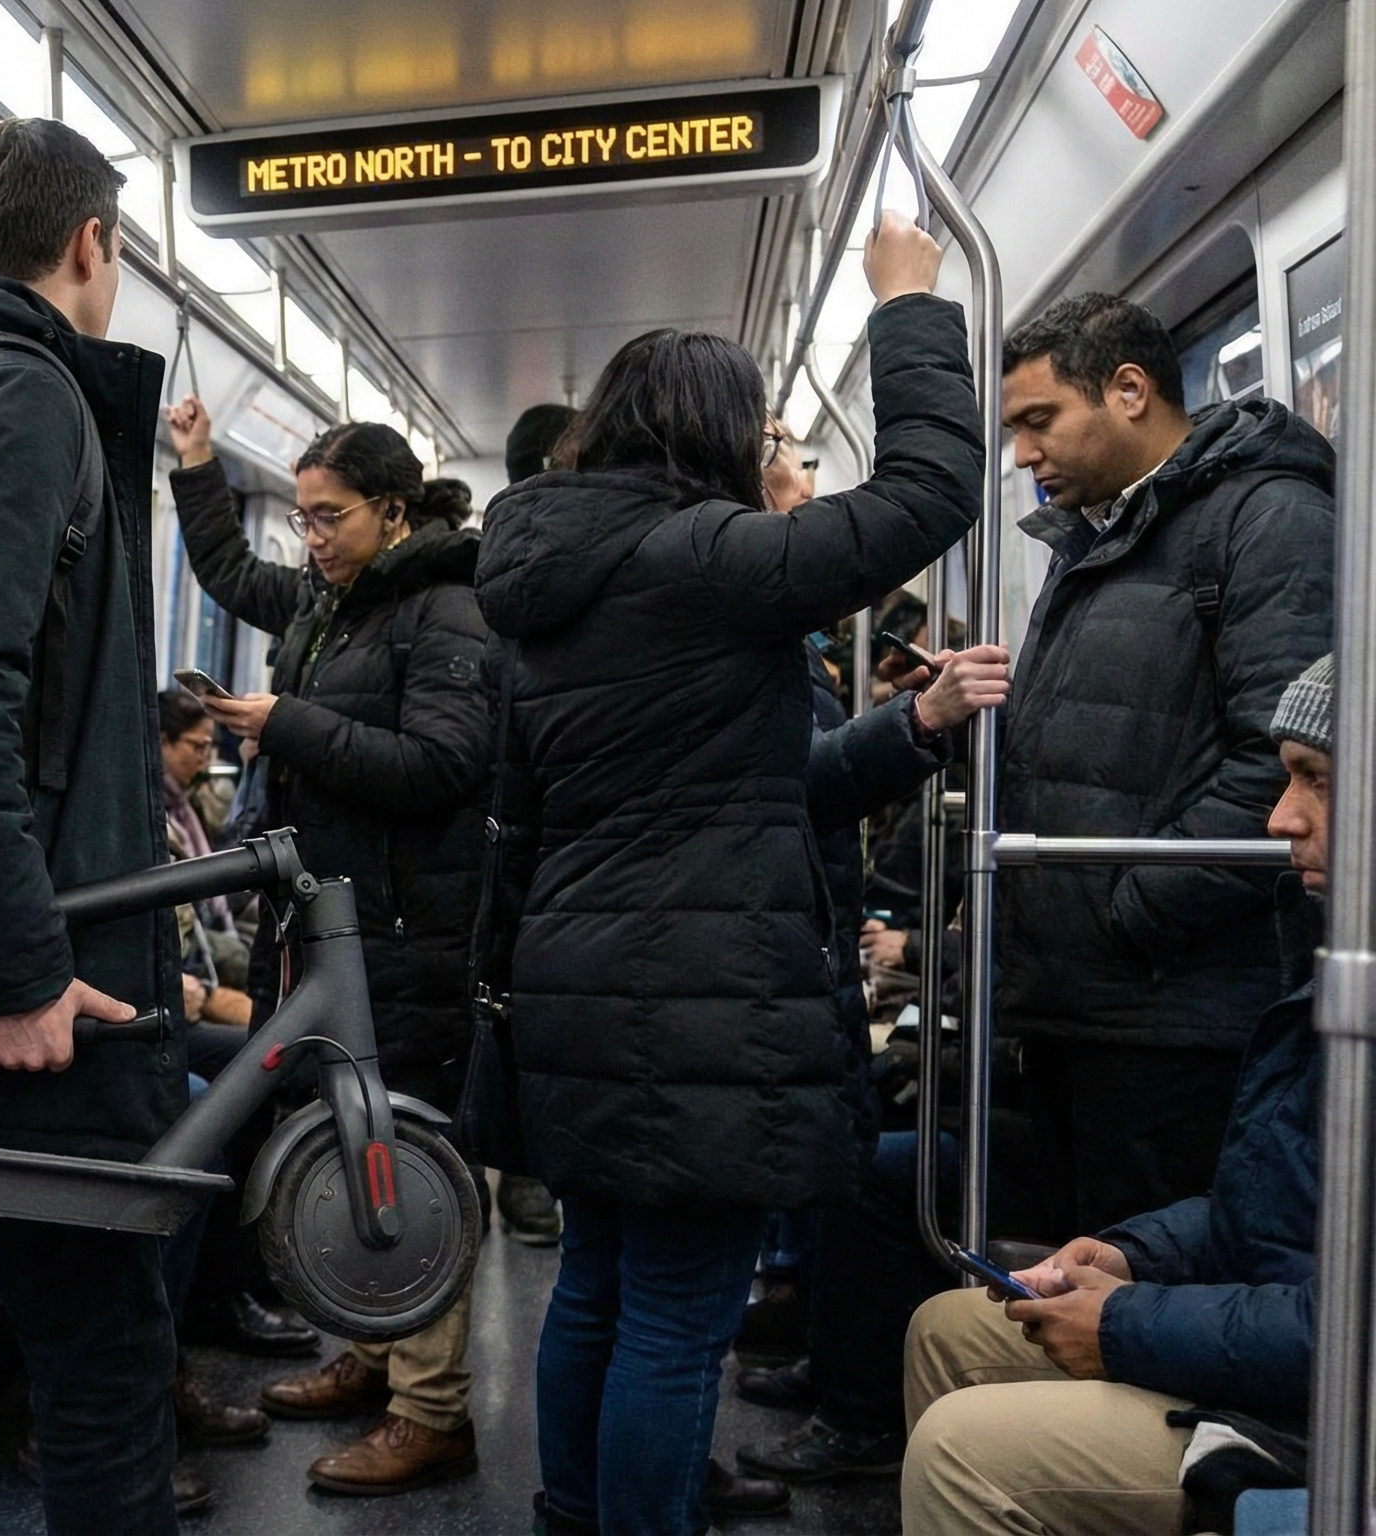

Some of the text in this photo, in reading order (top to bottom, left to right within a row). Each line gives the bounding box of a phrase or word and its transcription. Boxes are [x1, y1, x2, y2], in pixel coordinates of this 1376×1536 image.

[247, 115, 753, 192] METRO NORTH - TO CITY CENTER
